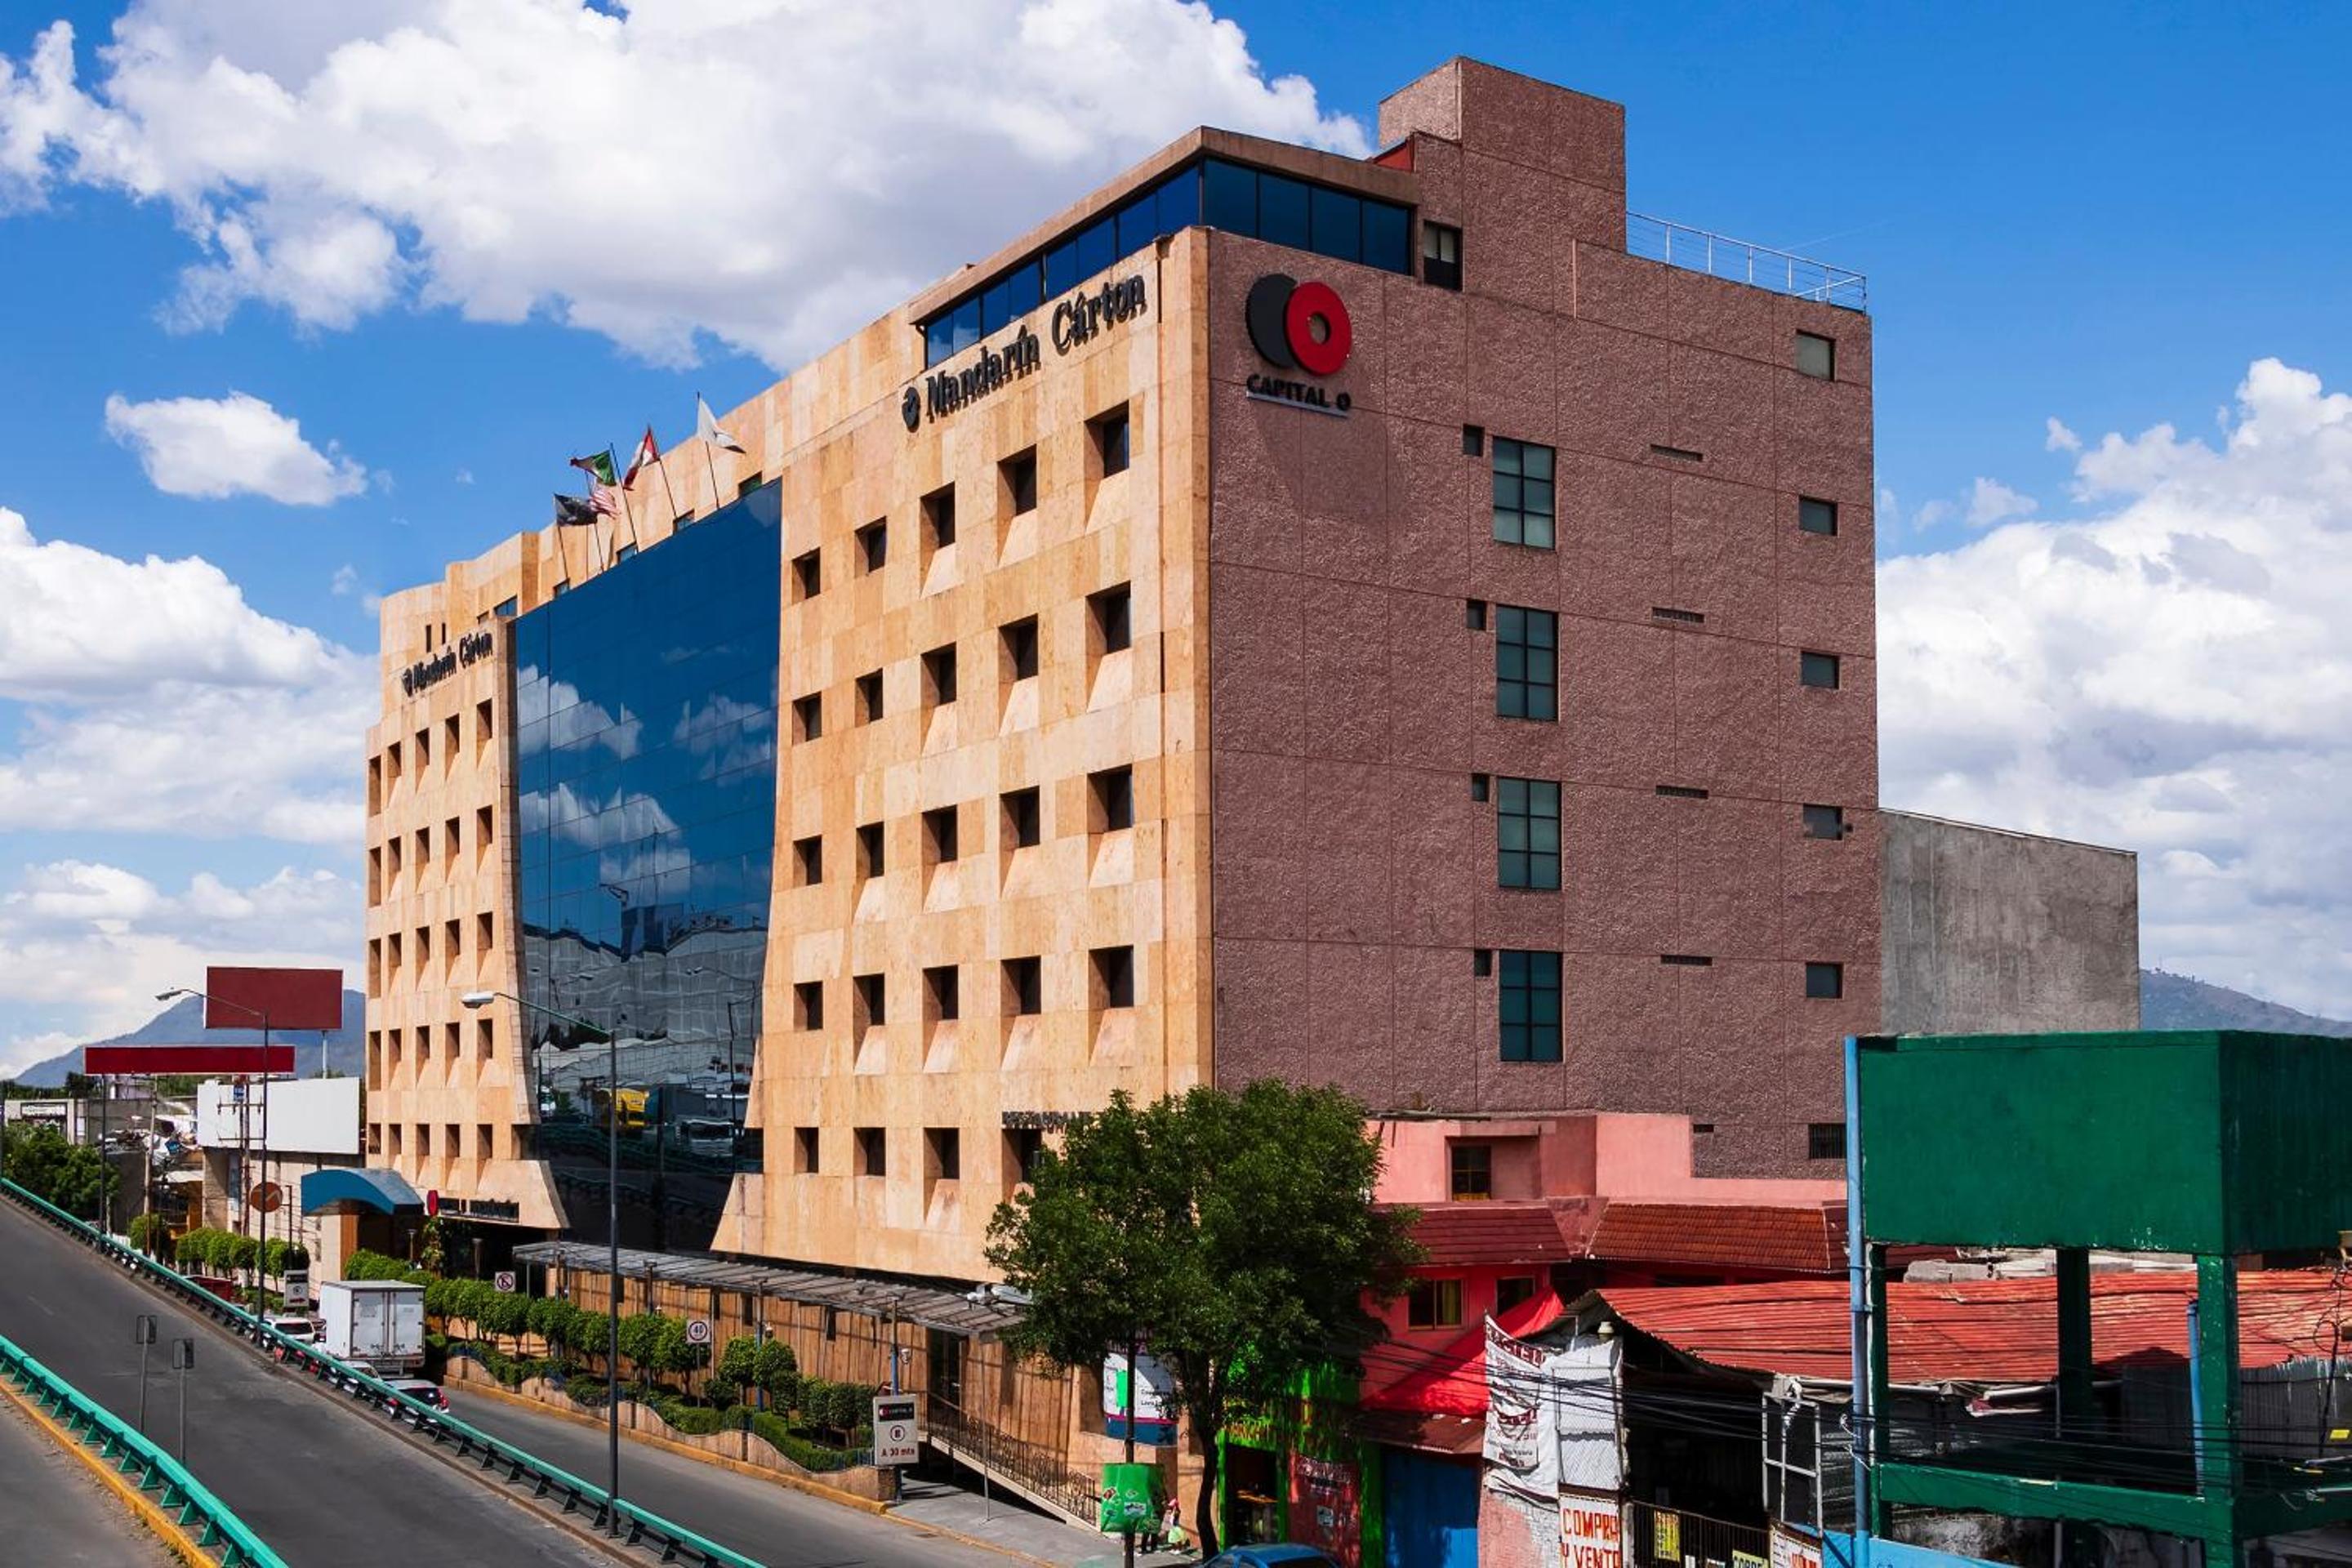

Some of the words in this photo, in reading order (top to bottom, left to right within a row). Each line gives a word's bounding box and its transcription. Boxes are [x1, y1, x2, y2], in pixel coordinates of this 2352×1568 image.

[1246, 374, 1330, 408] CAPITAL
[1337, 392, 1352, 410] O
[1563, 1508, 1619, 1540] COMPRA
